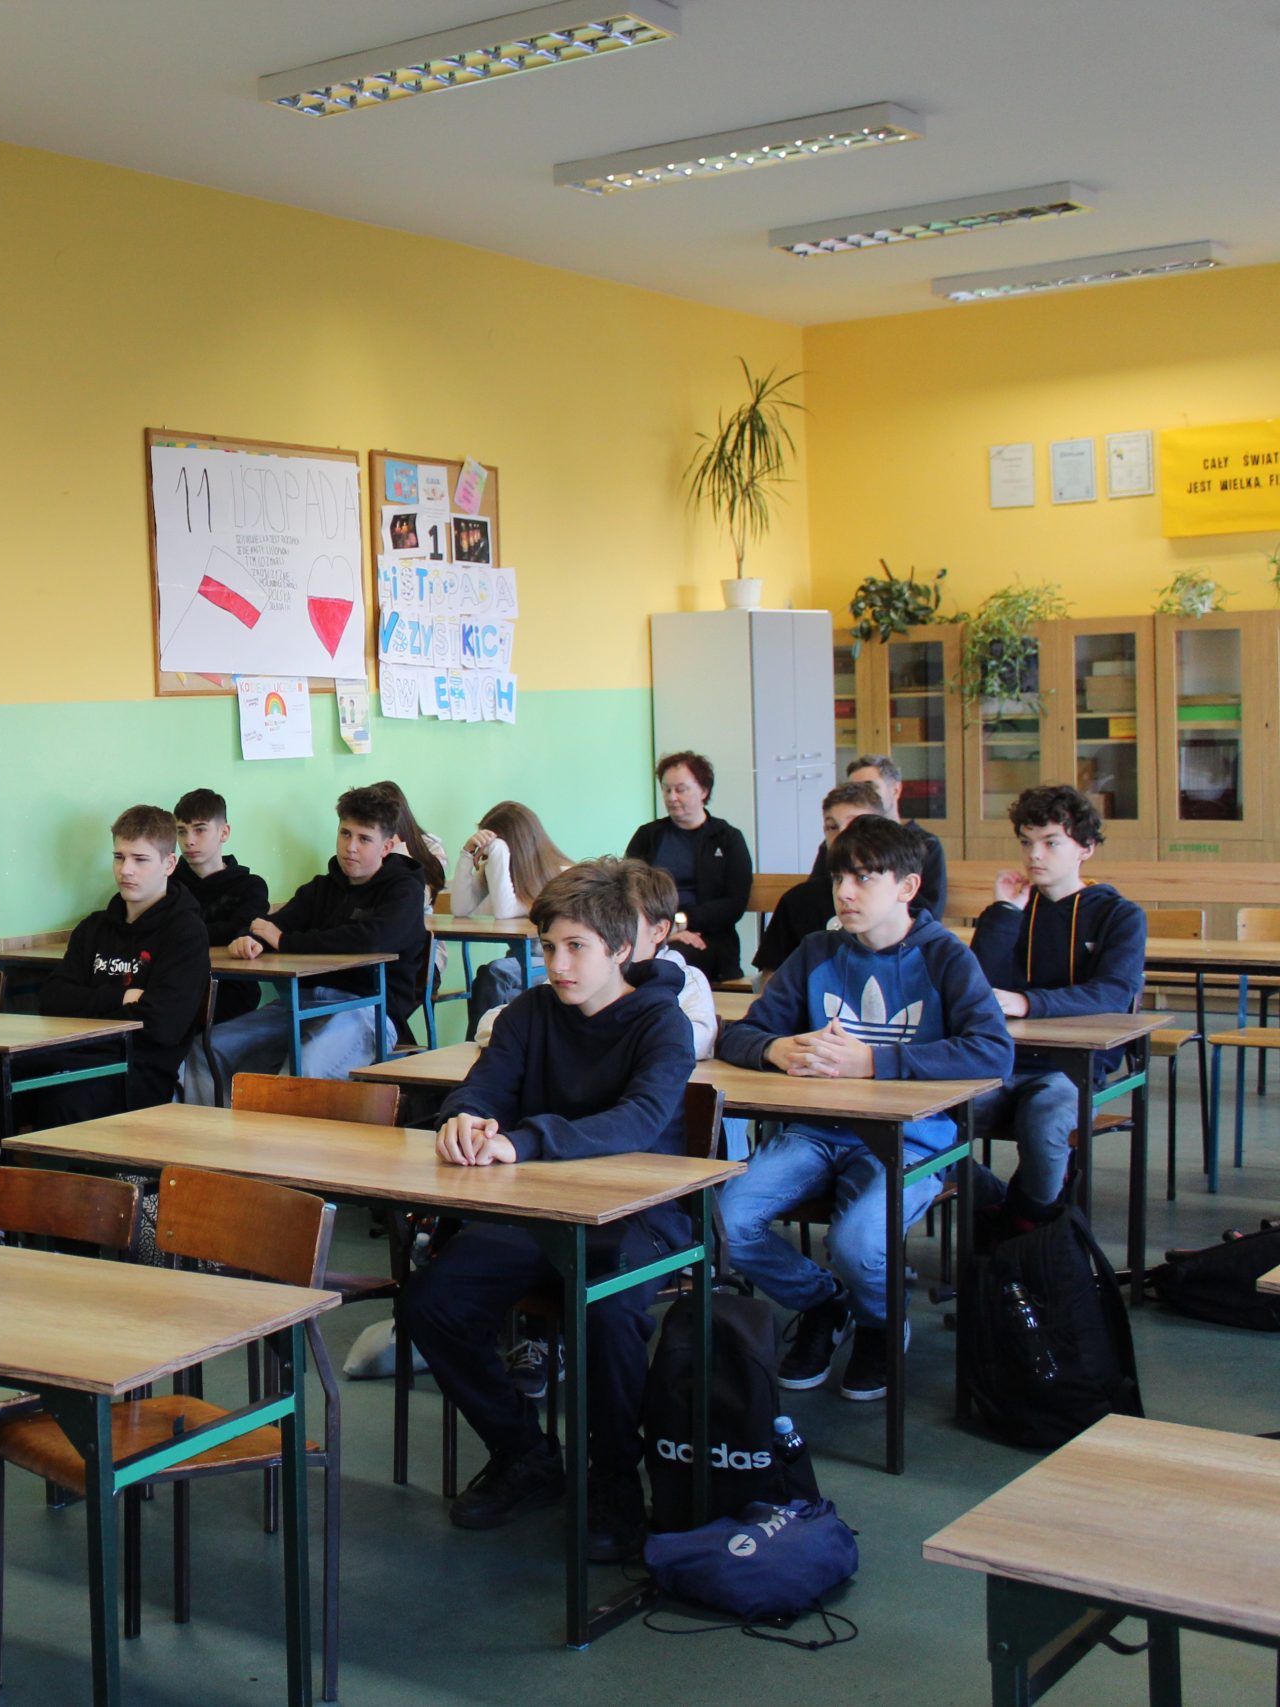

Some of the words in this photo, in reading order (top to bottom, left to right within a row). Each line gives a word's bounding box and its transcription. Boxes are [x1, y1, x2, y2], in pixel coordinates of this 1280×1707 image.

[1203, 456, 1229, 471] CAŁY
[176, 466, 211, 533] 11
[1187, 480, 1211, 494] JEST
[428, 525, 443, 560] 1
[657, 1439, 772, 1470] addas
